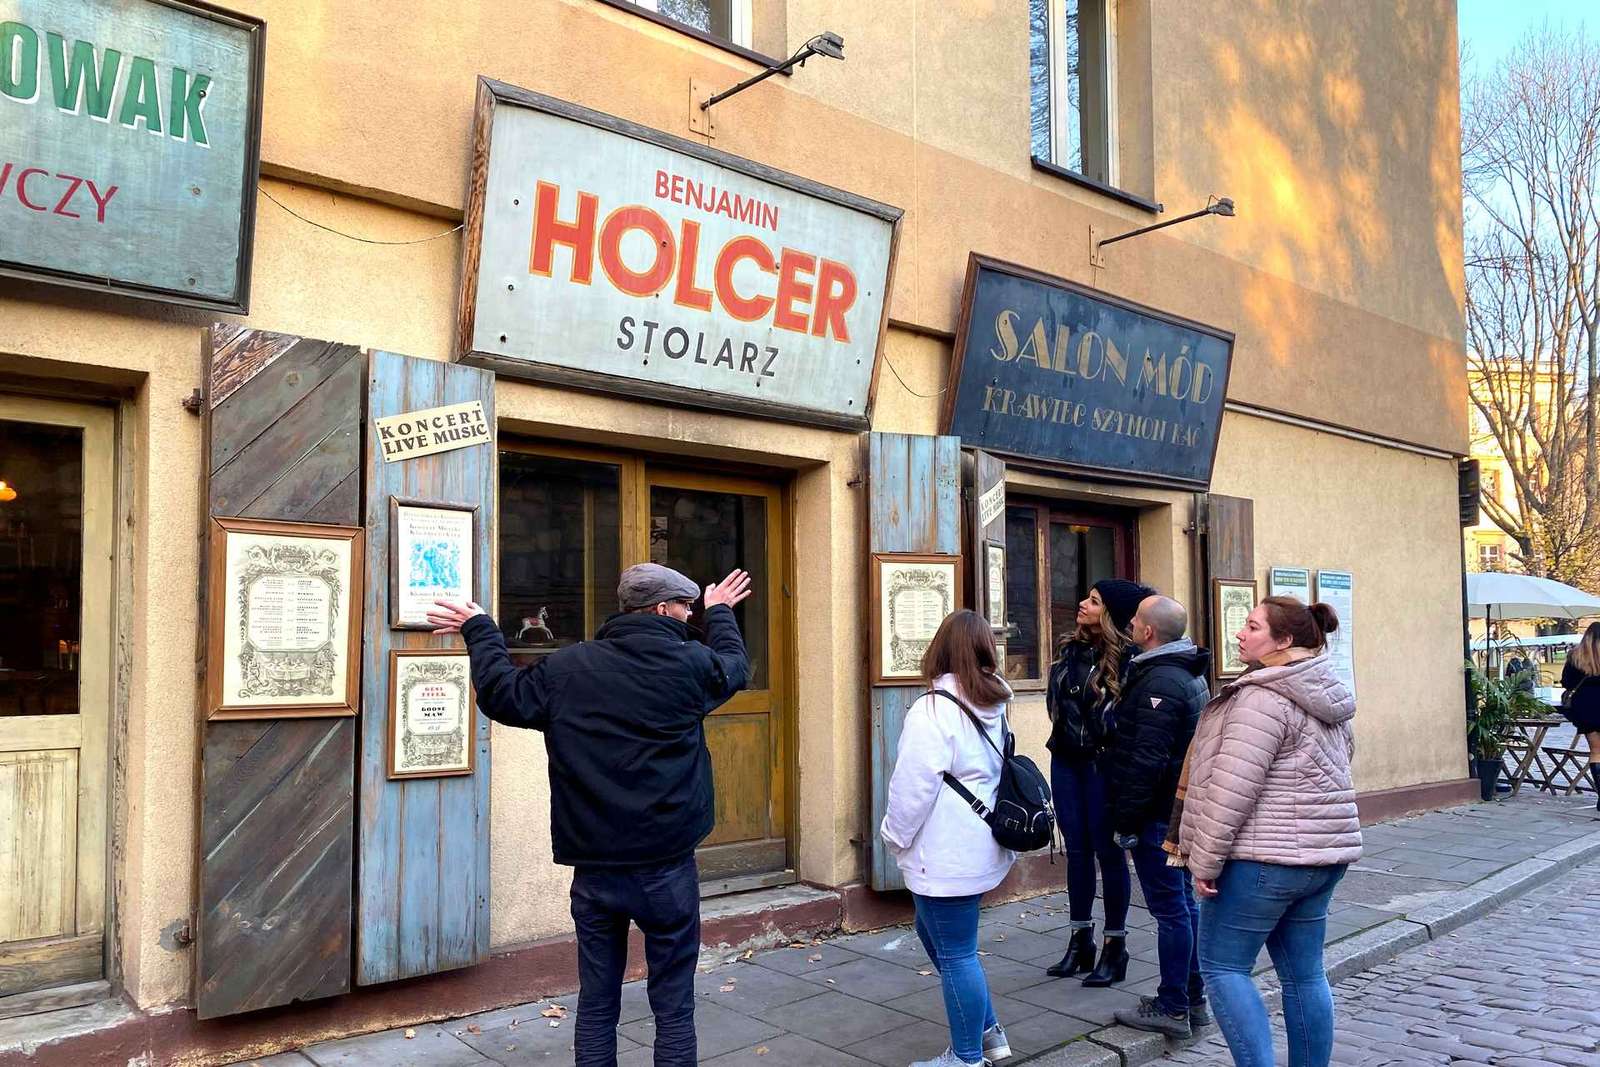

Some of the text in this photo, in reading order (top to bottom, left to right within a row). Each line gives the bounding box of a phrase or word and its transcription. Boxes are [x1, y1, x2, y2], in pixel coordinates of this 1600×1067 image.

[0, 162, 119, 224] CZY
[654, 169, 779, 232] BENJAMIN
[528, 178, 858, 344] HOLCER
[616, 315, 780, 378] STOLARZ
[990, 310, 1214, 405] SALON MÓD
[379, 409, 482, 440] KONCERT
[383, 424, 487, 455] LIVE MUSIC
[981, 385, 1086, 428] KRAWIEC
[1091, 407, 1168, 443] SZYMON
